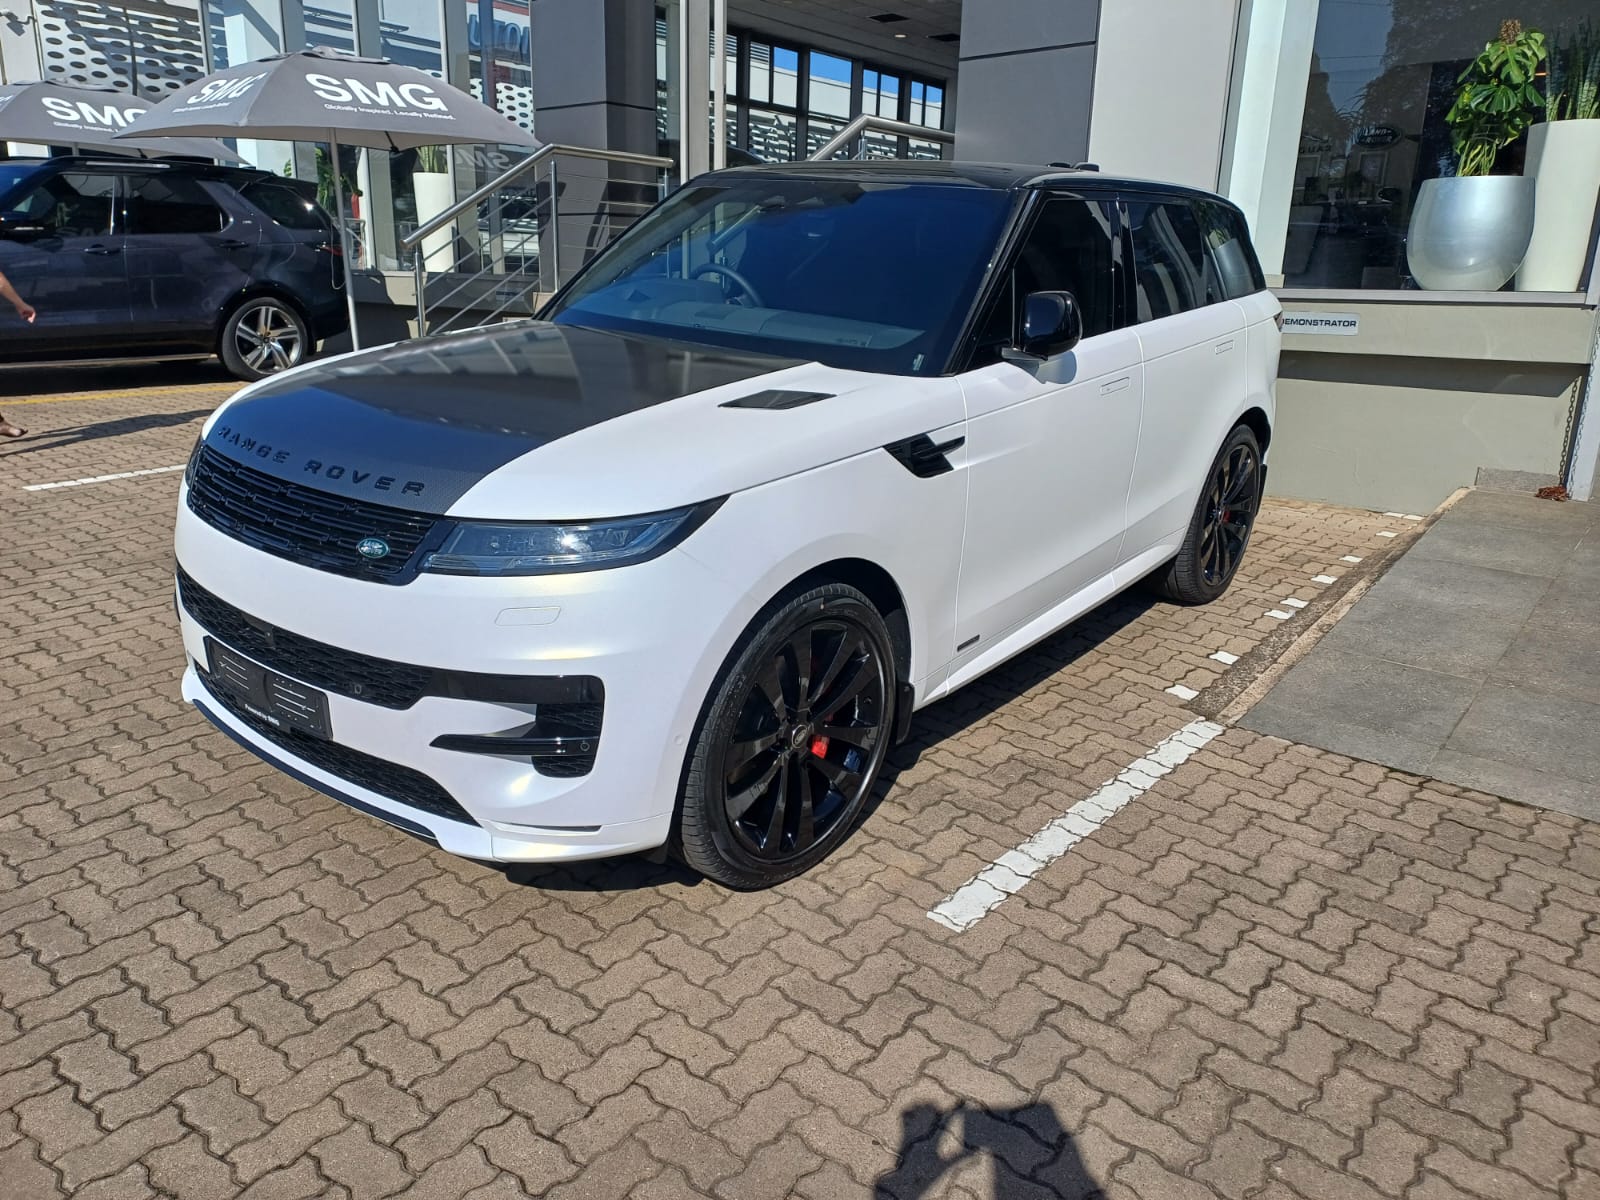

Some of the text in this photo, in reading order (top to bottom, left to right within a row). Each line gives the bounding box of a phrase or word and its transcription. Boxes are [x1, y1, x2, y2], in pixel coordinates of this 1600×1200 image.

[187, 72, 268, 104] SMG
[305, 73, 449, 112] SMG
[1282, 318, 1357, 327] EMONSTRATOR
[218, 426, 425, 496] RANGE ROVER
